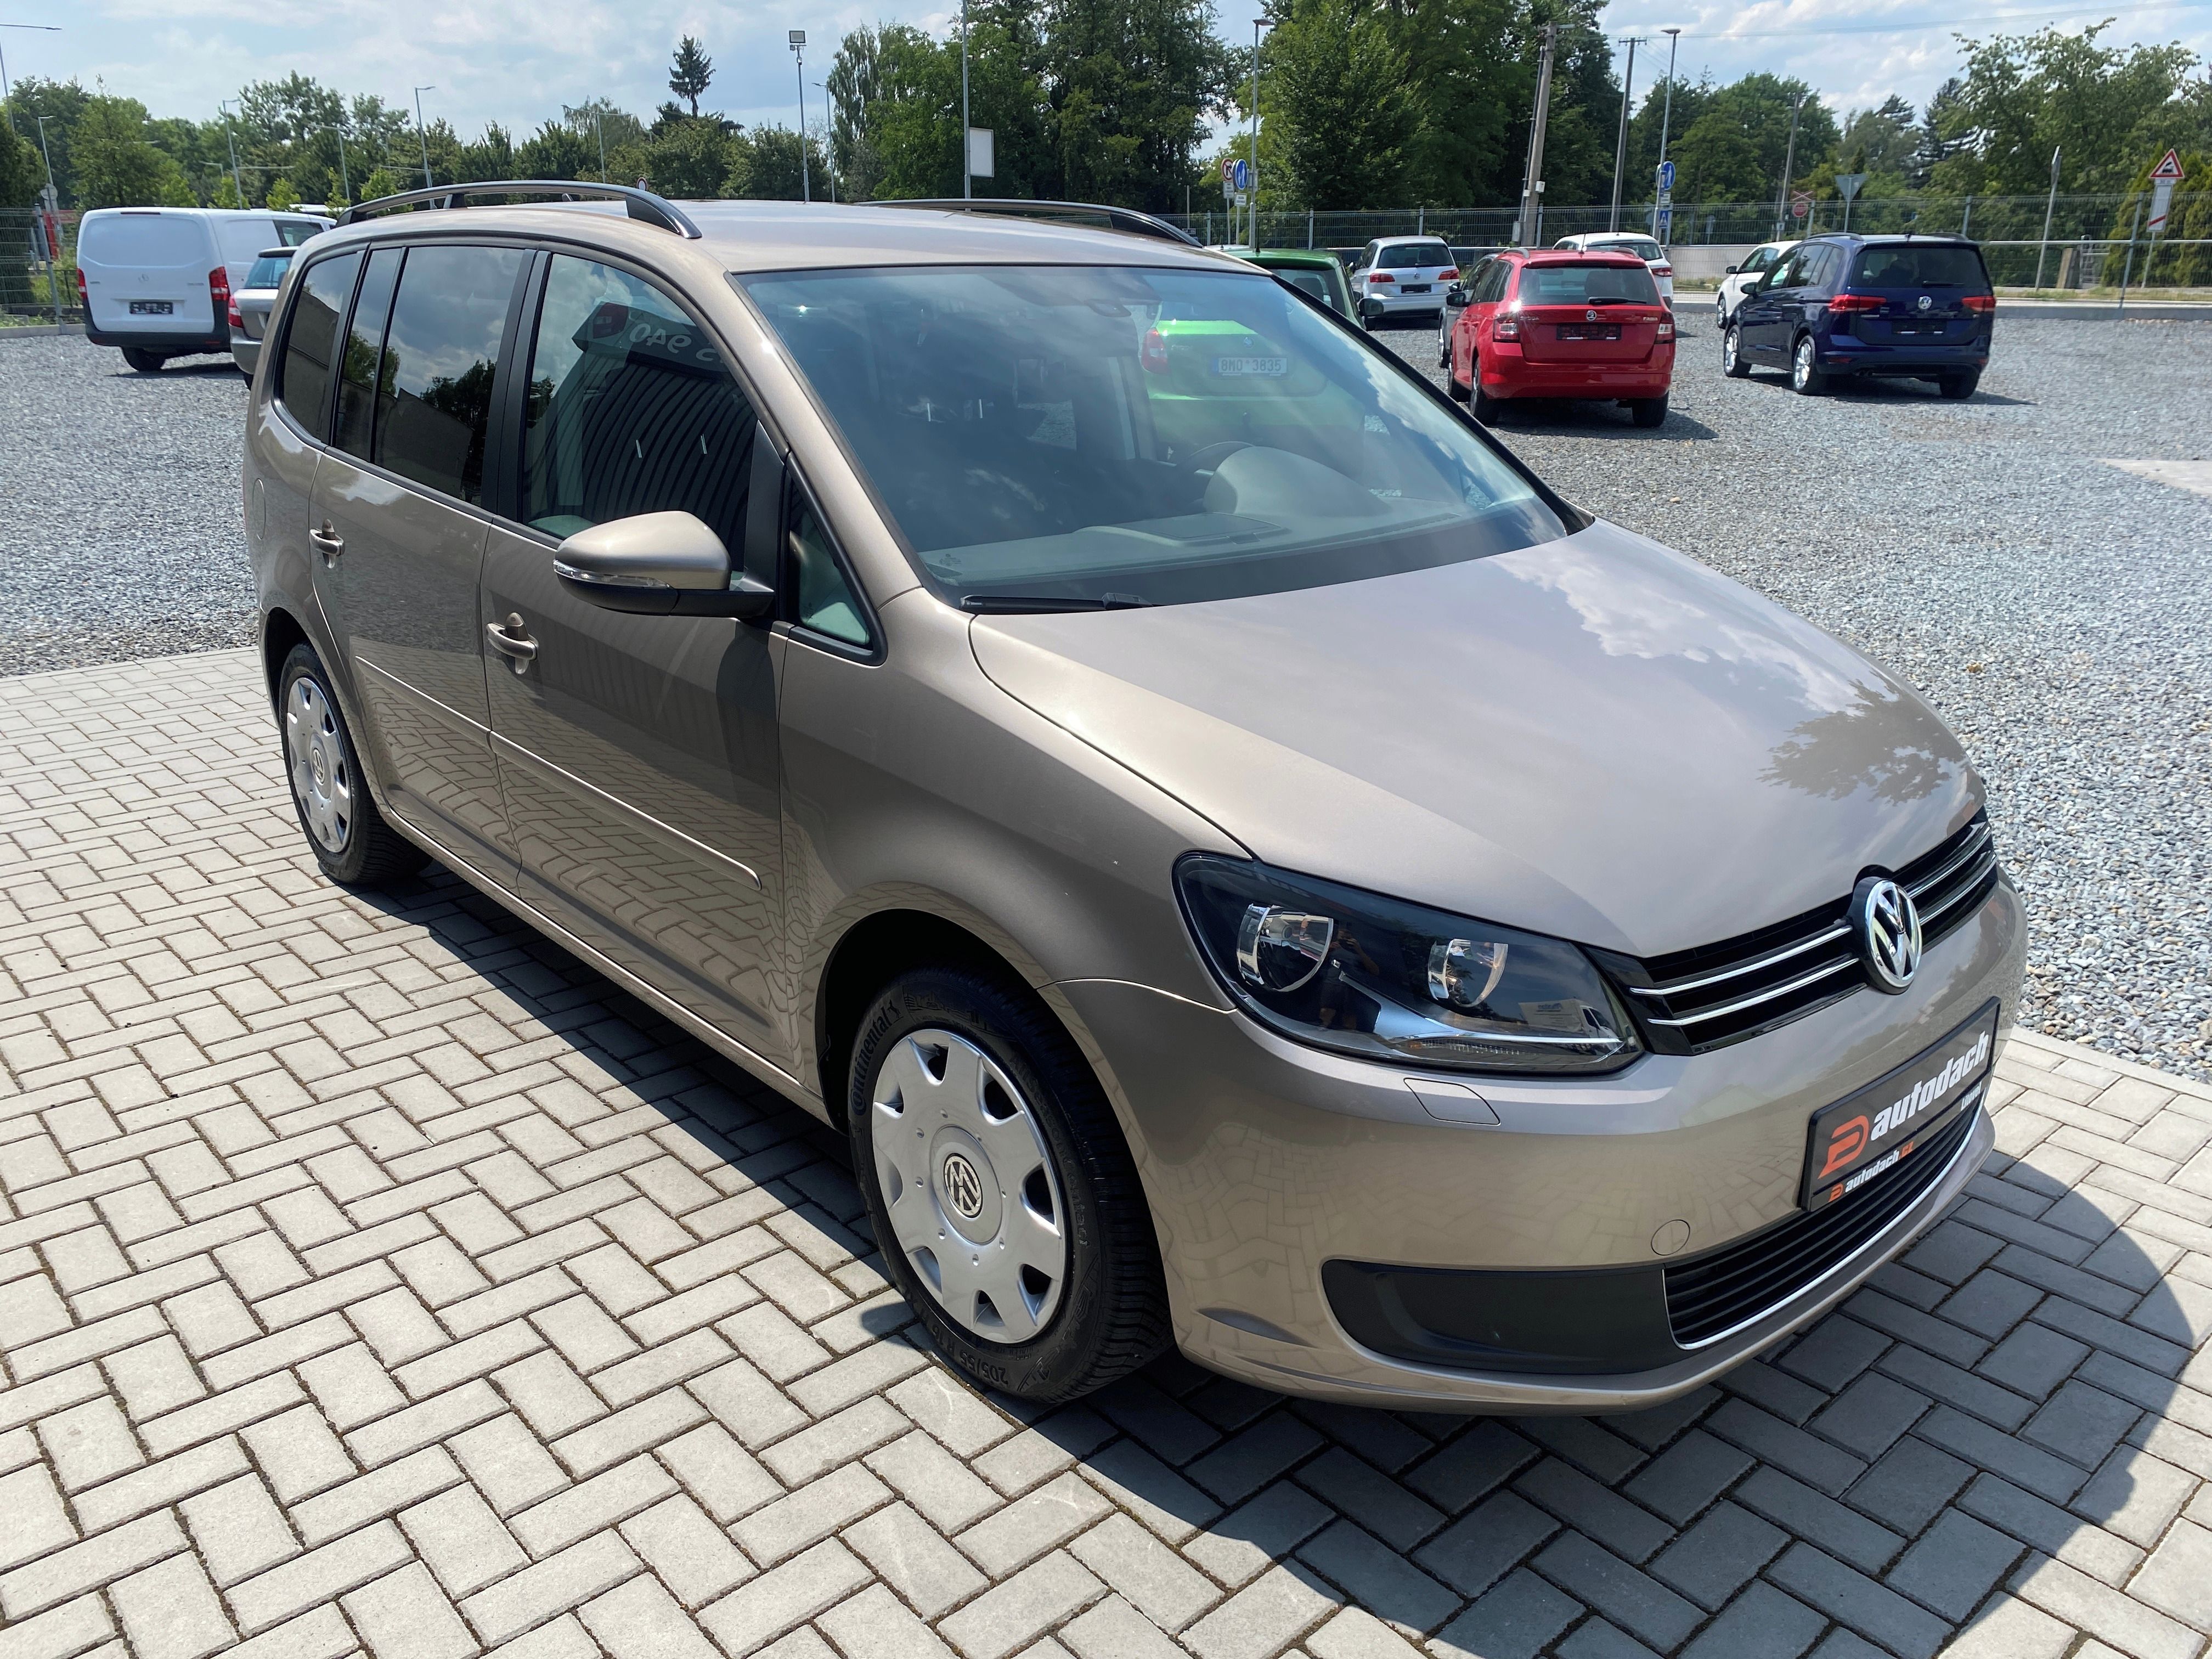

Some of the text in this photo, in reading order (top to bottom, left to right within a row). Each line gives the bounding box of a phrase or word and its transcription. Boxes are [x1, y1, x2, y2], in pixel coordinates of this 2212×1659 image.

[1252, 359, 1282, 372] 3835
[850, 1006, 893, 1116] Continental
[1871, 1030, 1989, 1141] autodach
[1844, 1141, 1915, 1193] autodach.cz
[959, 1350, 1009, 1386] 205/55
